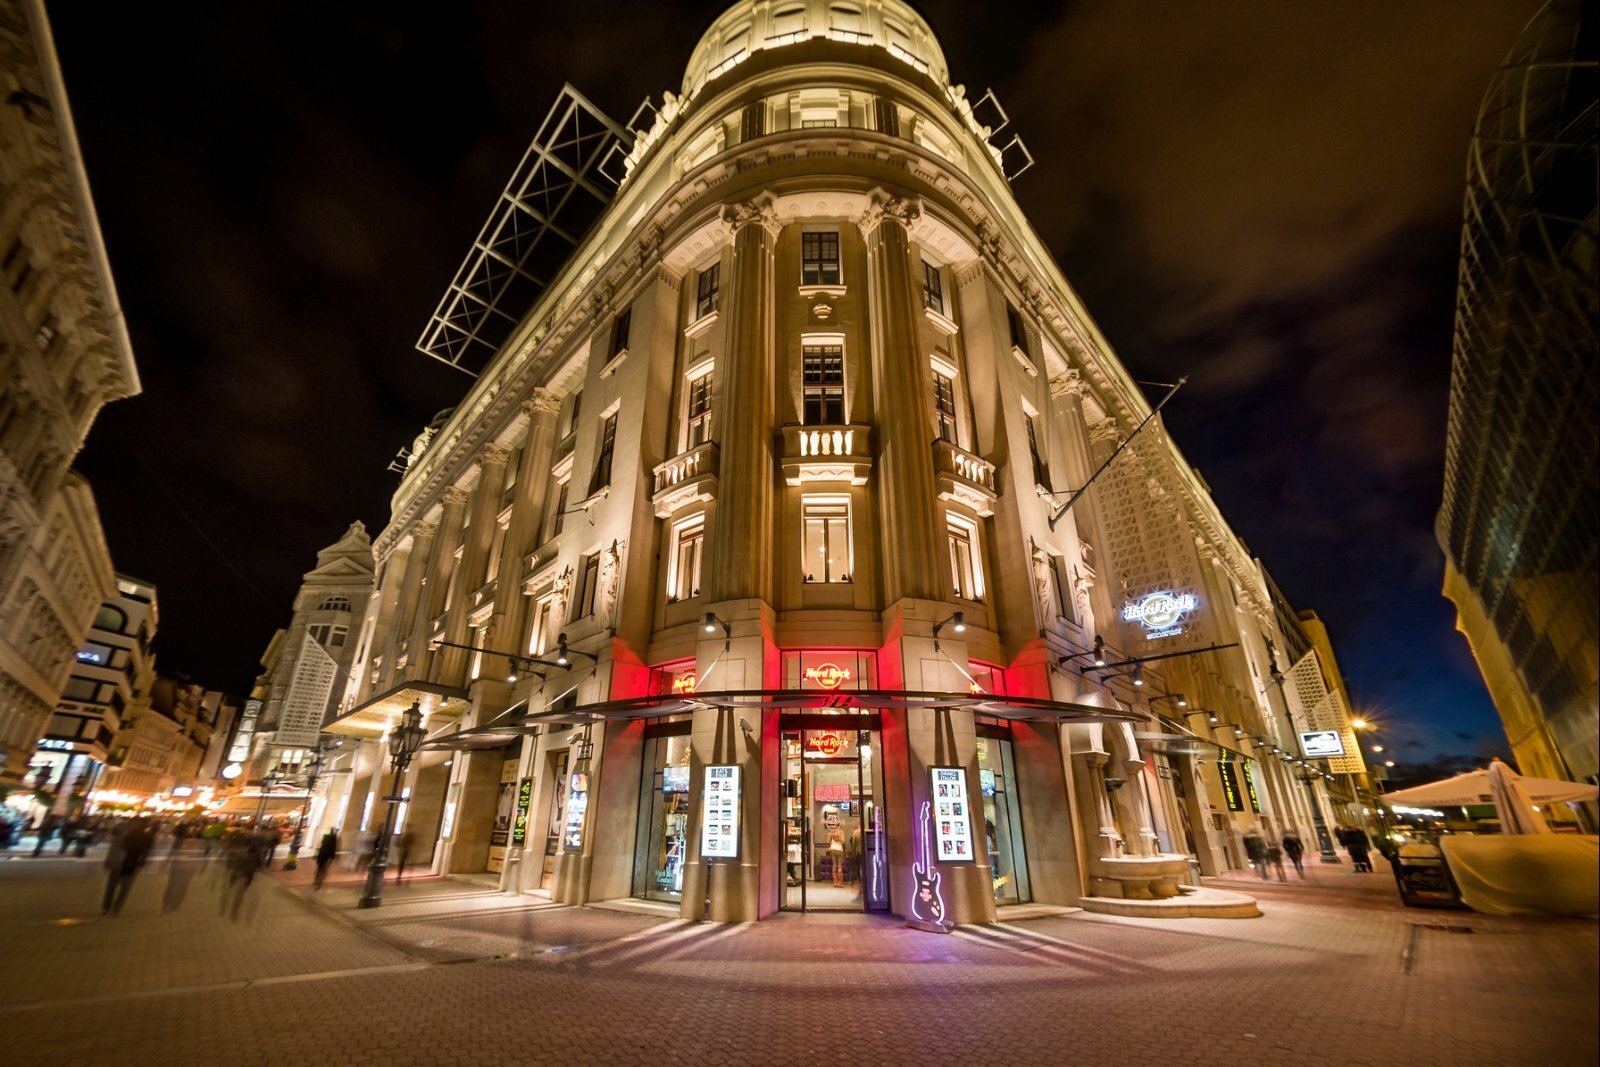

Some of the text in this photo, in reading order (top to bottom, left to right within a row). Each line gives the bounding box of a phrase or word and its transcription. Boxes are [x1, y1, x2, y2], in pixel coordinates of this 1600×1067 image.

[1123, 602, 1157, 618] Hard
[1159, 594, 1194, 613] Rock
[806, 668, 851, 680] Hard Rock
[809, 737, 849, 748] Hard Rock
[814, 784, 850, 801] CAFE
